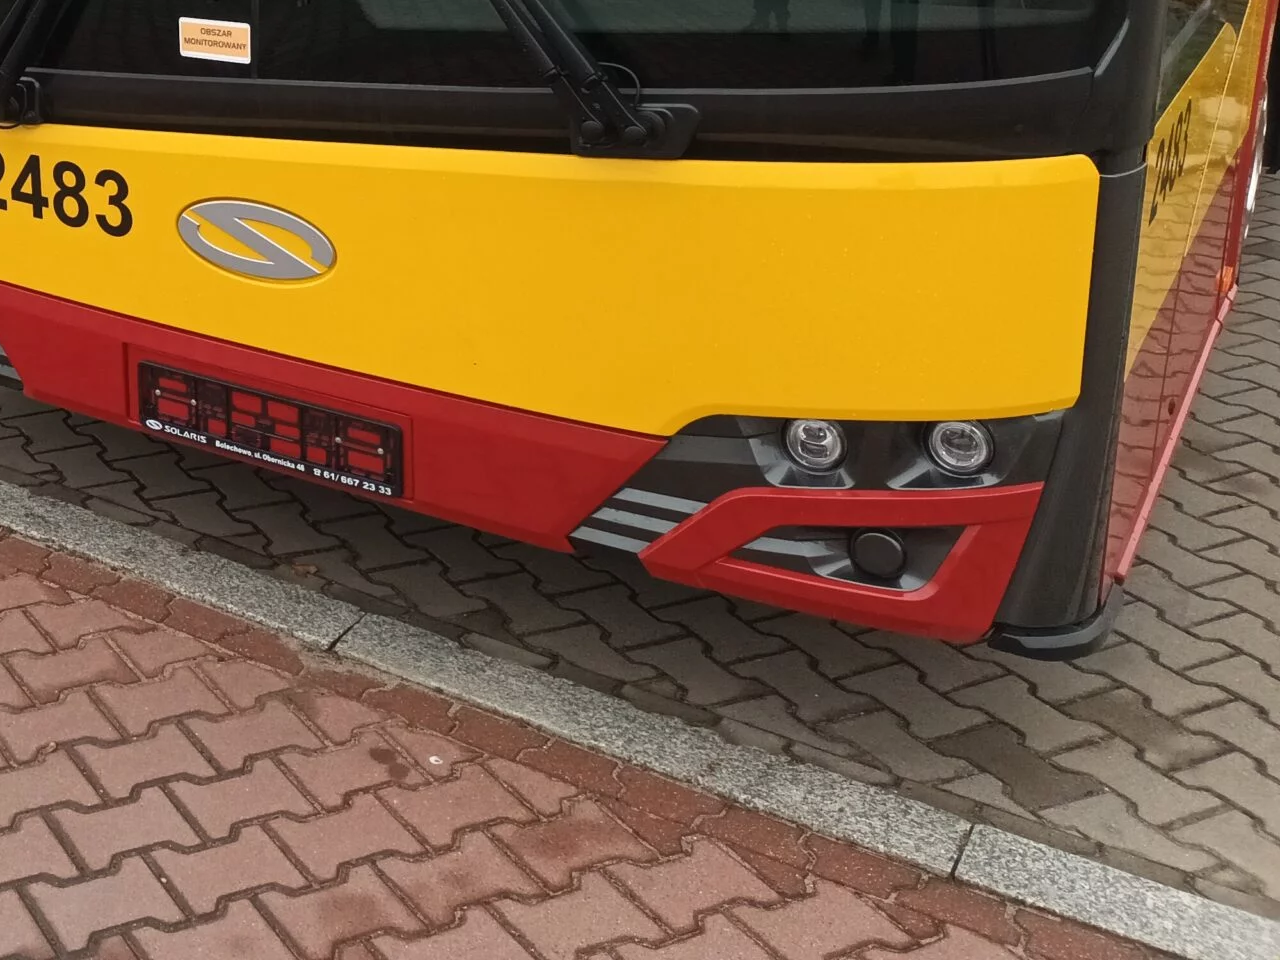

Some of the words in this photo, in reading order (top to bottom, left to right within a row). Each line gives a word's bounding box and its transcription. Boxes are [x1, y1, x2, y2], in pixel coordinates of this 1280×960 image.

[184, 37, 247, 50] MONITOROWANY
[200, 28, 232, 38] OBSZAR
[1148, 99, 1192, 227] 2483
[164, 425, 208, 444] SOLARIS
[215, 440, 253, 457] Bolechowo,
[340, 475, 360, 487] 667
[362, 481, 376, 491] 23
[378, 485, 392, 496] 33
